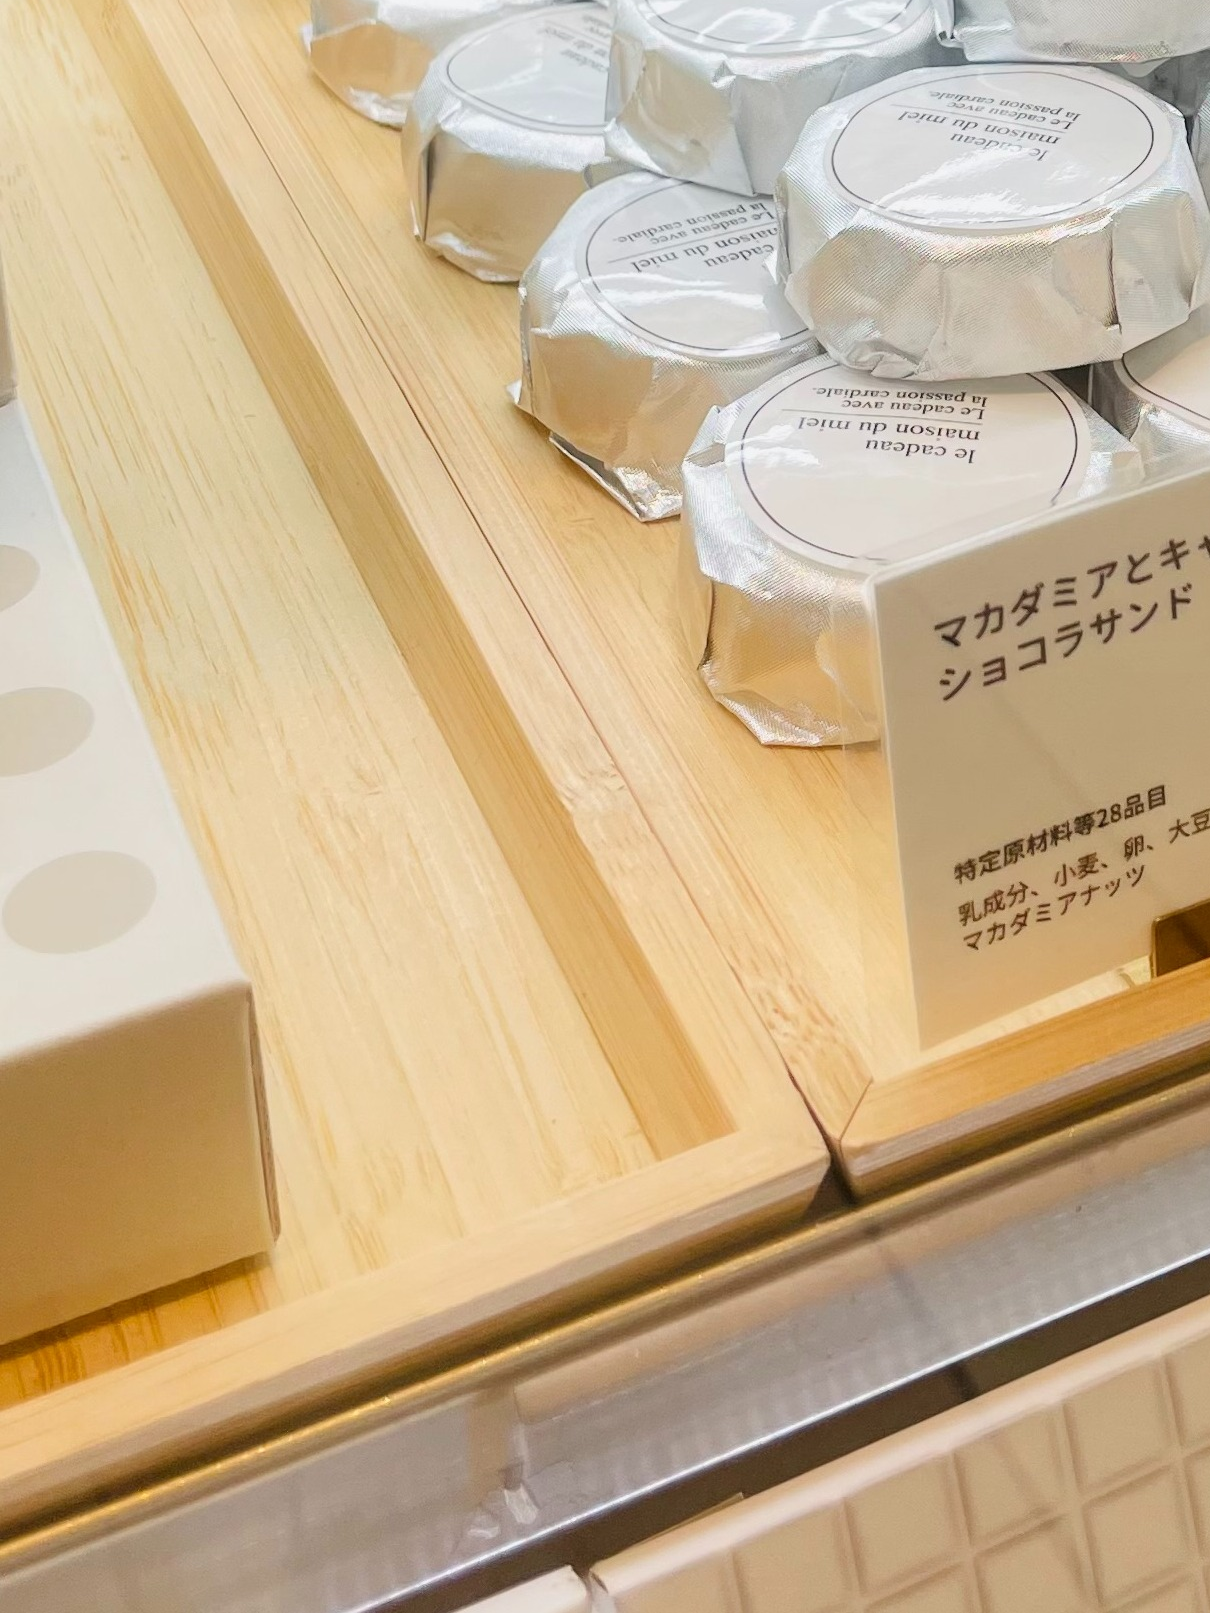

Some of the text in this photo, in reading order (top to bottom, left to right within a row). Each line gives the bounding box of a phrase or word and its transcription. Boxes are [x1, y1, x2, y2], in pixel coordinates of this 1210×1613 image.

[947, 102, 1073, 129] Le cadeau avec
[1000, 100, 1063, 114] passion
[1066, 112, 1081, 121] la
[898, 111, 1061, 144] maison du miel
[950, 133, 1048, 161] le cadeau
[686, 205, 746, 226] passion
[749, 203, 767, 211] la
[651, 212, 774, 244] Le cadeau avec
[631, 252, 679, 272] miel
[683, 246, 709, 257] du
[704, 244, 774, 267] cadeau
[813, 388, 987, 407] la passion cardiale.
[841, 400, 984, 419] Le cadeau avec
[799, 417, 980, 441] maison du miel
[866, 440, 975, 463] le cadeau
[939, 583, 1193, 702] ショコラサンド
[953, 784, 1166, 885] 特定原材料等28品目
[963, 864, 1145, 951] マカダミアナッツ
